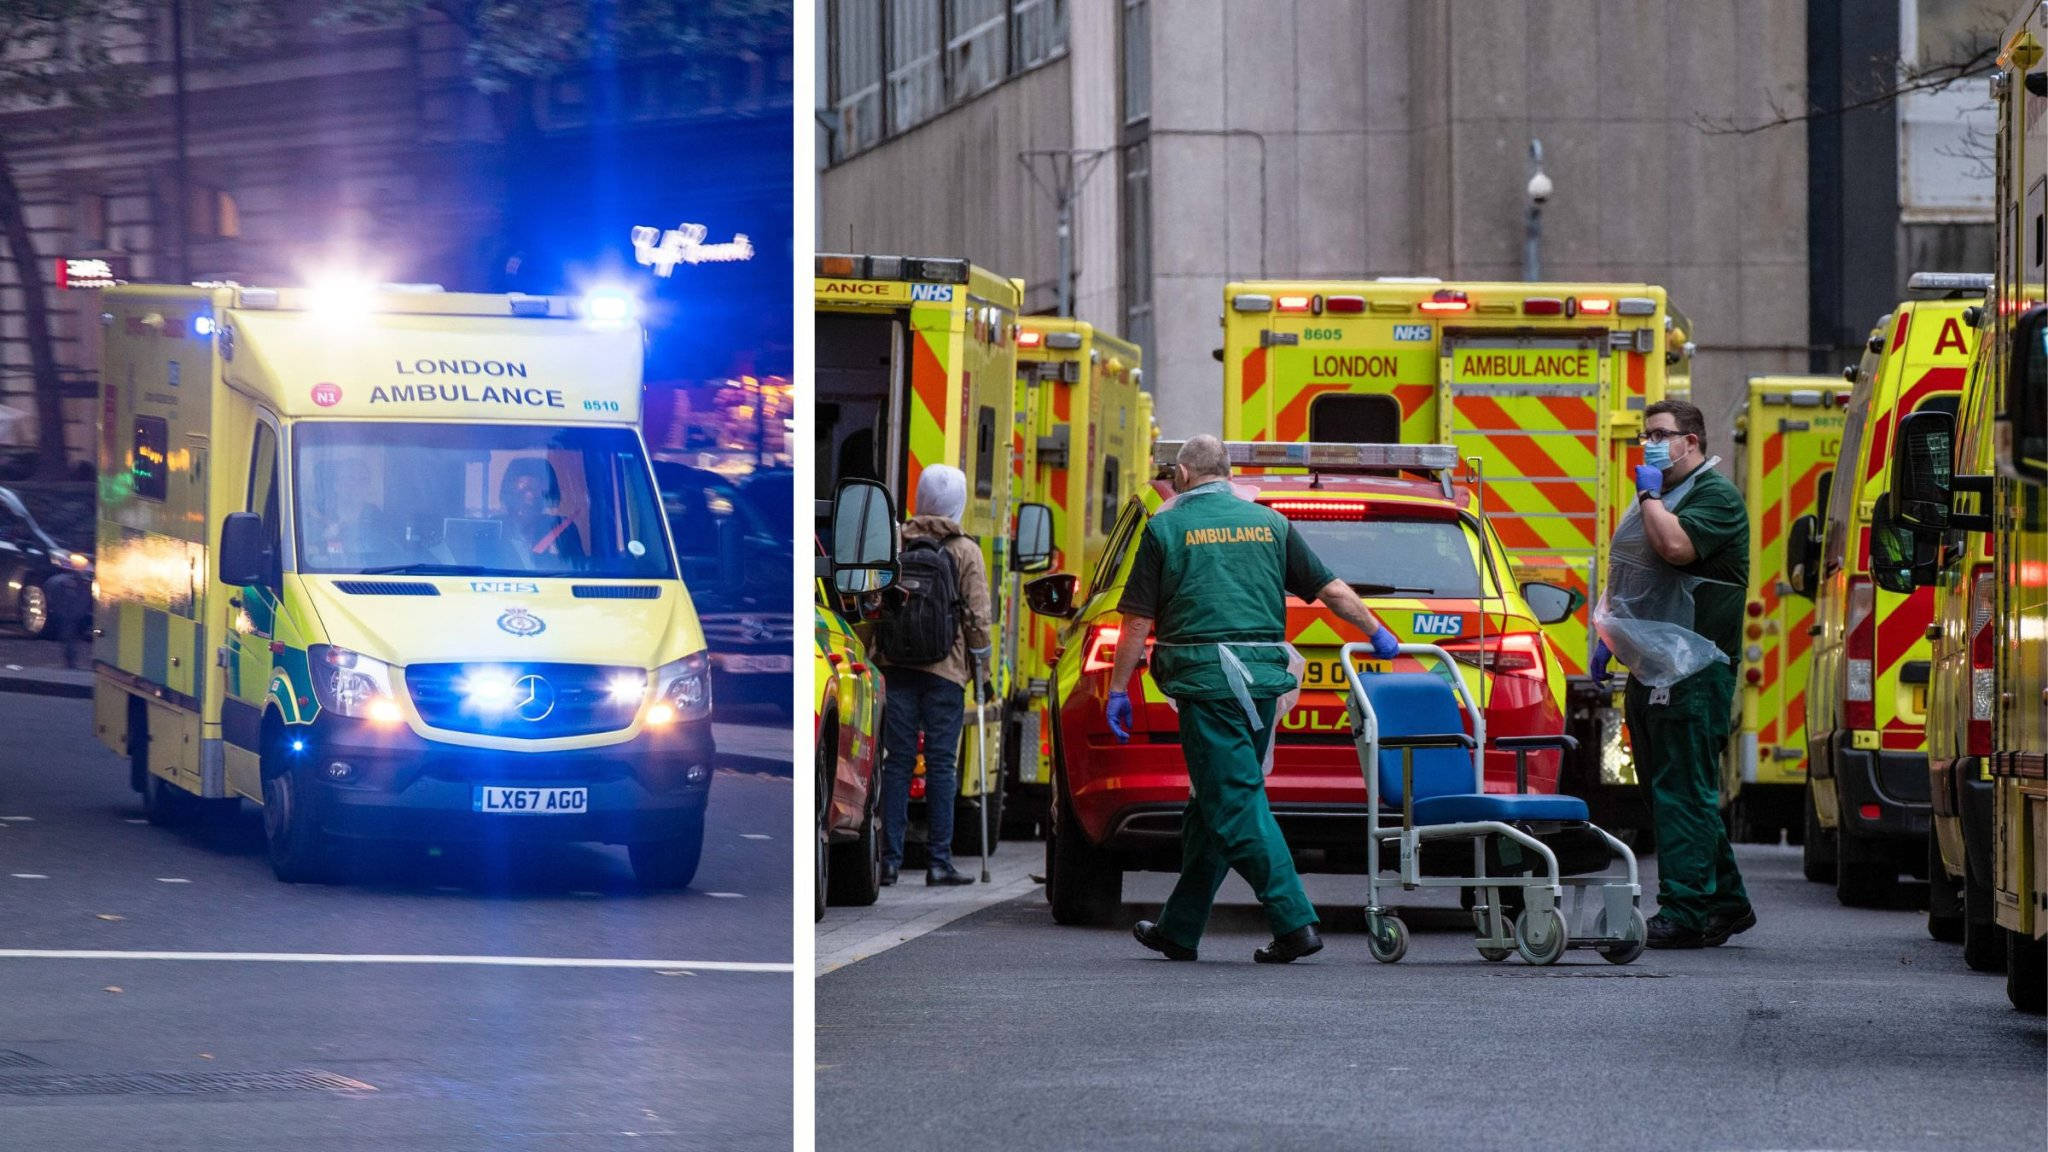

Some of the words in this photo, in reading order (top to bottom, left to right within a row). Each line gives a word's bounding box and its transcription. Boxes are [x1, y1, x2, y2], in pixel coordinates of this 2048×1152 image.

[815, 282, 889, 296] ANCE
[911, 284, 952, 301] NHS
[1304, 327, 1342, 340] 8605
[1394, 326, 1430, 340] NHS
[395, 359, 527, 377] LONDON
[1313, 355, 1398, 377] LONDON
[1462, 355, 1590, 377] AMBULANCE
[316, 391, 337, 403] N1
[369, 383, 565, 408] AMBULANCE
[582, 400, 619, 412] 8510
[1185, 526, 1274, 546] AMBULANCE
[470, 582, 539, 593] NHS
[1413, 613, 1462, 635] NHS
[487, 789, 540, 809] LX67
[546, 790, 584, 809] AGO
